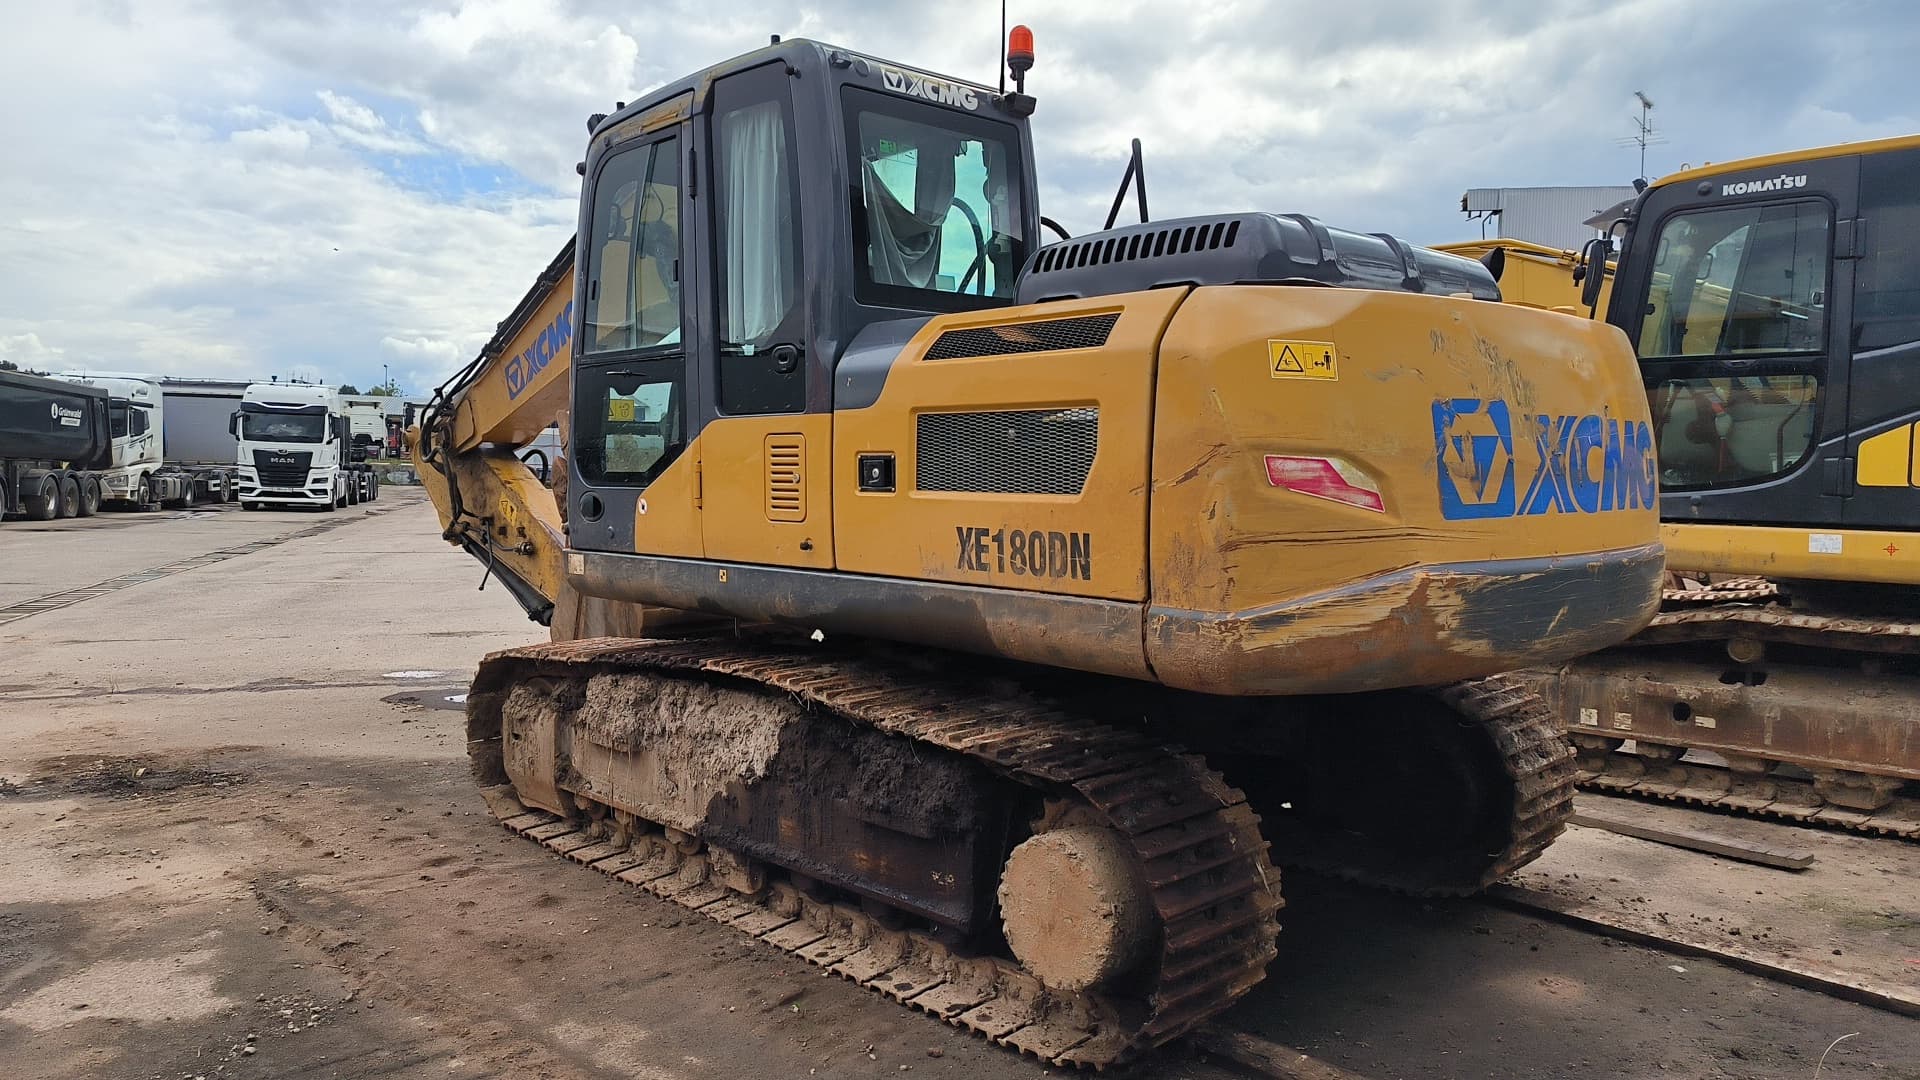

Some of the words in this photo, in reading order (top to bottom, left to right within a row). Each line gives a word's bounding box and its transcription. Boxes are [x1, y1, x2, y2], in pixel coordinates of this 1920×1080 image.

[906, 76, 979, 111] XCMG
[1722, 174, 1807, 196] KOMATSU
[1516, 414, 1655, 516] XCMG
[956, 526, 1091, 581] XE180DN
